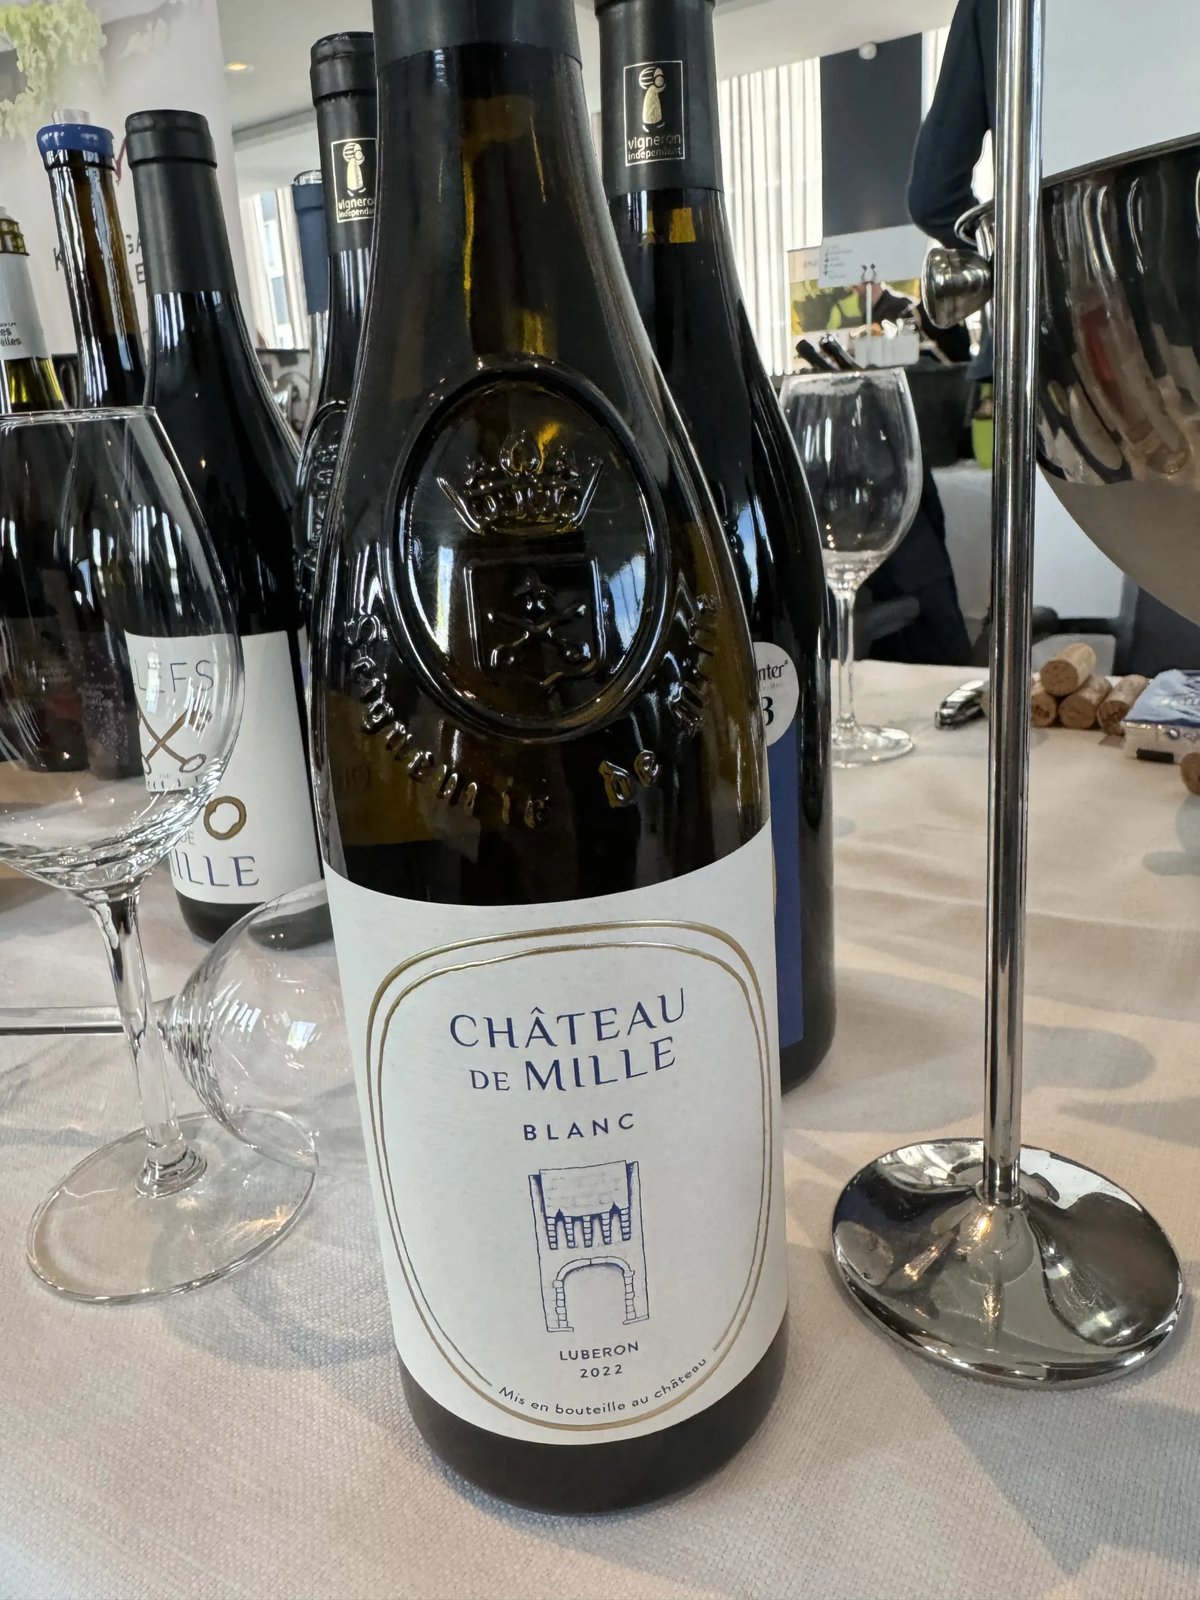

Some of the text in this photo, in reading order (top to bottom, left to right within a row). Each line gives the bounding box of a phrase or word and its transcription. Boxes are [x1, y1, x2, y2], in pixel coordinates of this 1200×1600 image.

[627, 134, 681, 150] vigneron
[338, 197, 374, 210] vignero
[449, 987, 686, 1049] CHÂTEAU
[469, 1036, 677, 1092] DE MILLE
[523, 1113, 635, 1141] BLANC
[559, 1341, 640, 1361] LUBERON
[579, 1364, 624, 1379] 2022
[498, 1359, 707, 1416] Mis en bouteille au château
